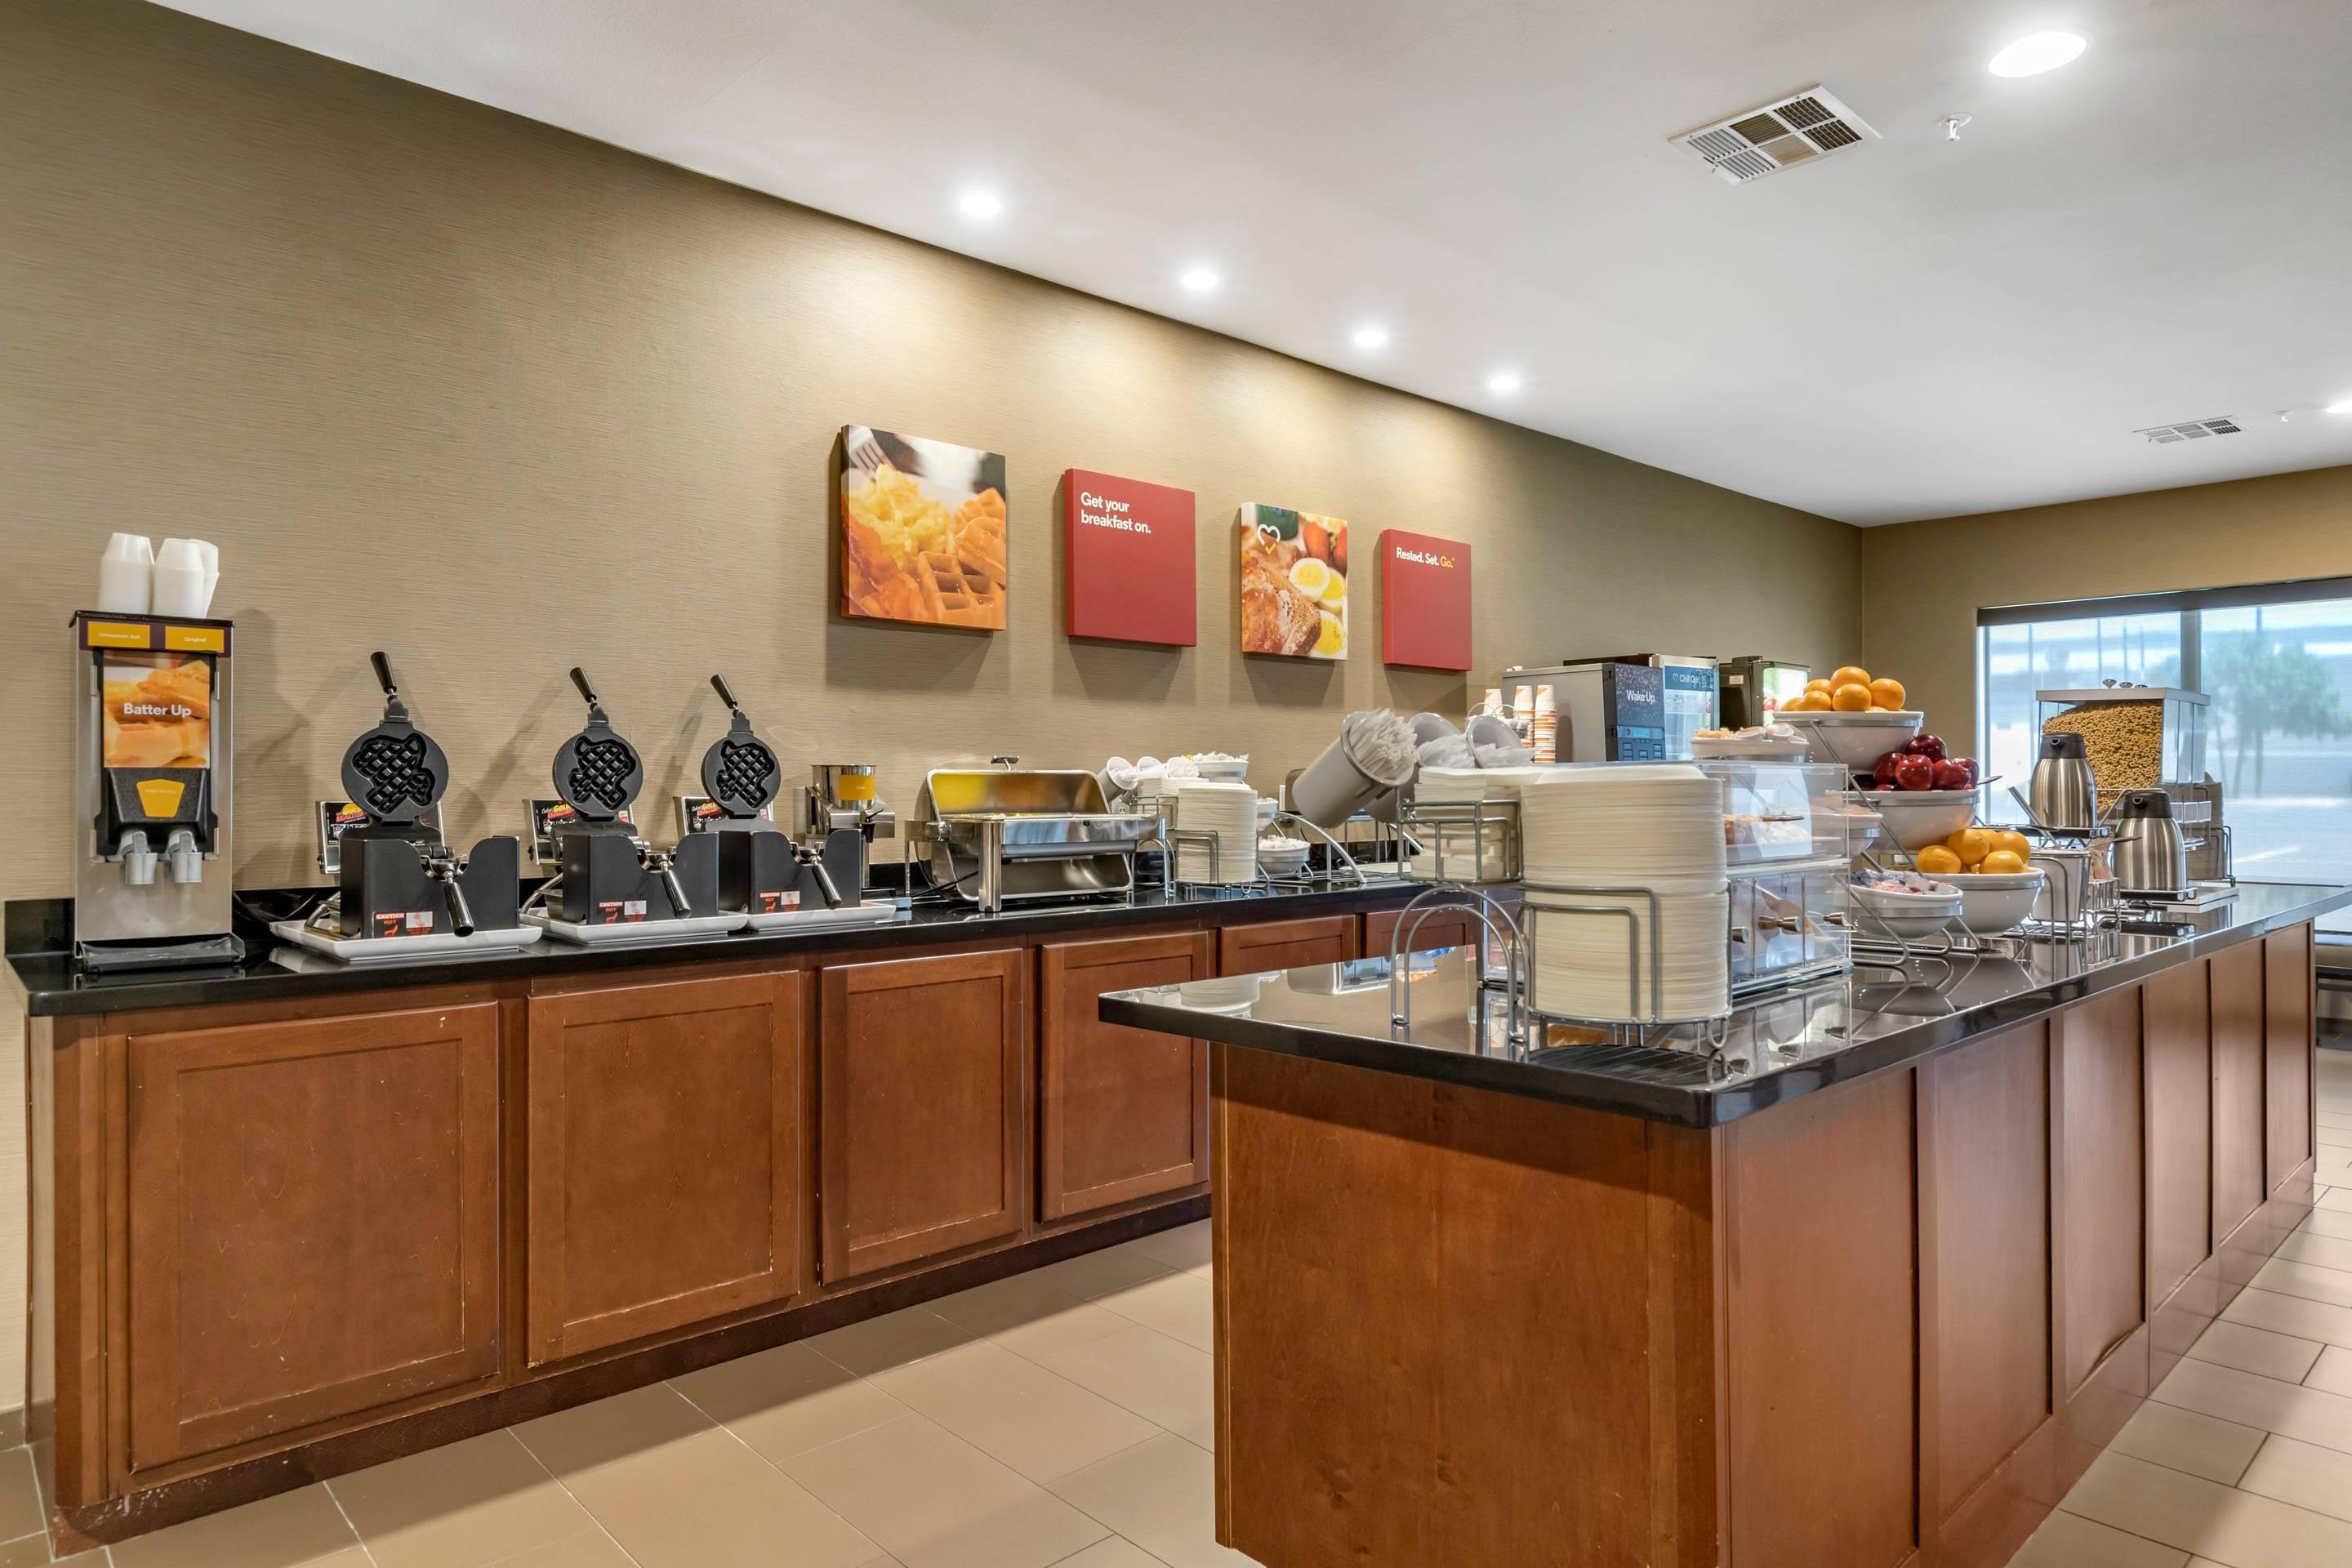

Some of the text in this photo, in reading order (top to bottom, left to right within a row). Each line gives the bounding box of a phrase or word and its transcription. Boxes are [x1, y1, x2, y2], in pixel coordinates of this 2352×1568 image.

[1080, 492, 1130, 513] Get your
[1080, 509, 1152, 534] breakfast on.
[1396, 546, 1424, 564] Rested.
[1425, 552, 1440, 566] Set.
[184, 635, 207, 644] Original
[1679, 674, 1690, 683] Chill
[1626, 689, 1655, 705] Wake Up
[123, 702, 192, 719] Batter Up
